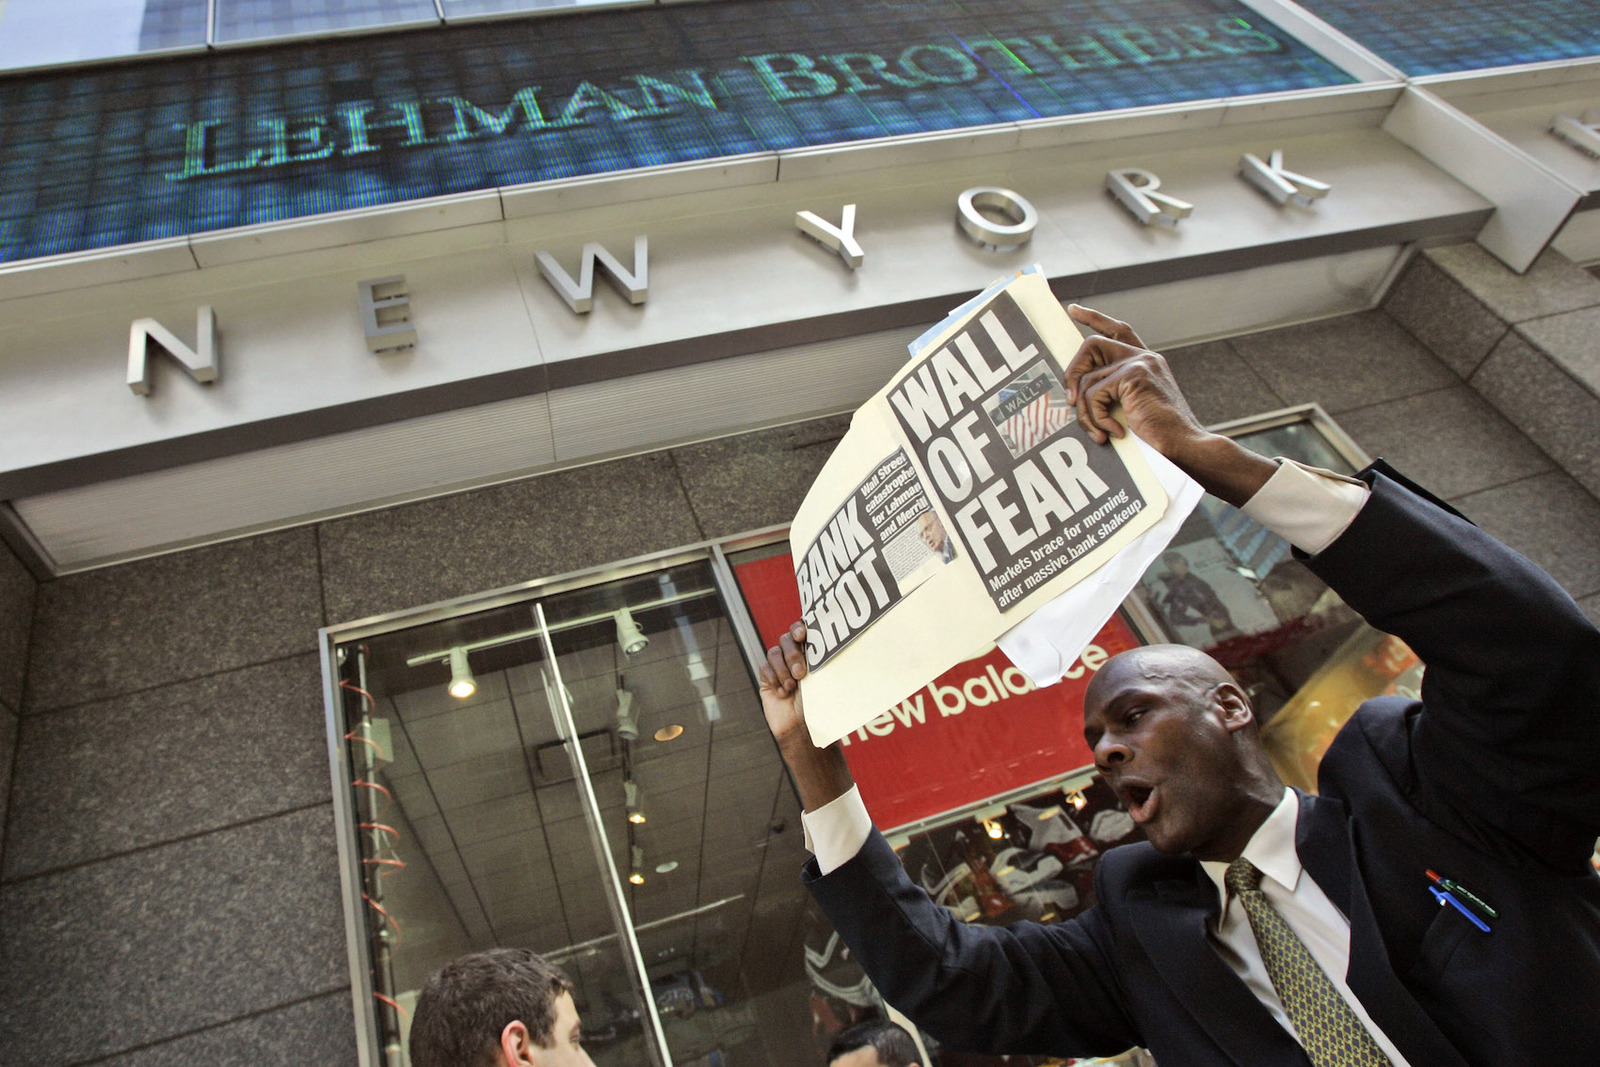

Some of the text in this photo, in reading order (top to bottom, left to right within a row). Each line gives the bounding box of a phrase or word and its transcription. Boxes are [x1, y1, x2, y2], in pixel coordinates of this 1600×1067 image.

[165, 17, 1283, 181] LEHMAN BROTHERS
[126, 150, 1331, 396] NEW YORK
[890, 309, 1039, 443] WALL
[1005, 388, 1040, 413] WALL
[860, 452, 907, 497] Wall Street
[864, 466, 915, 513] catastrophe
[871, 481, 922, 527] for Lehman
[927, 409, 995, 502] OF
[954, 436, 1110, 575] FEAR
[796, 495, 875, 616] BANK
[880, 495, 930, 541] and Merrill
[988, 488, 1129, 592] Markets brace for morning
[998, 499, 1142, 607] after massive bank shakeup
[802, 546, 890, 666] SHOT
